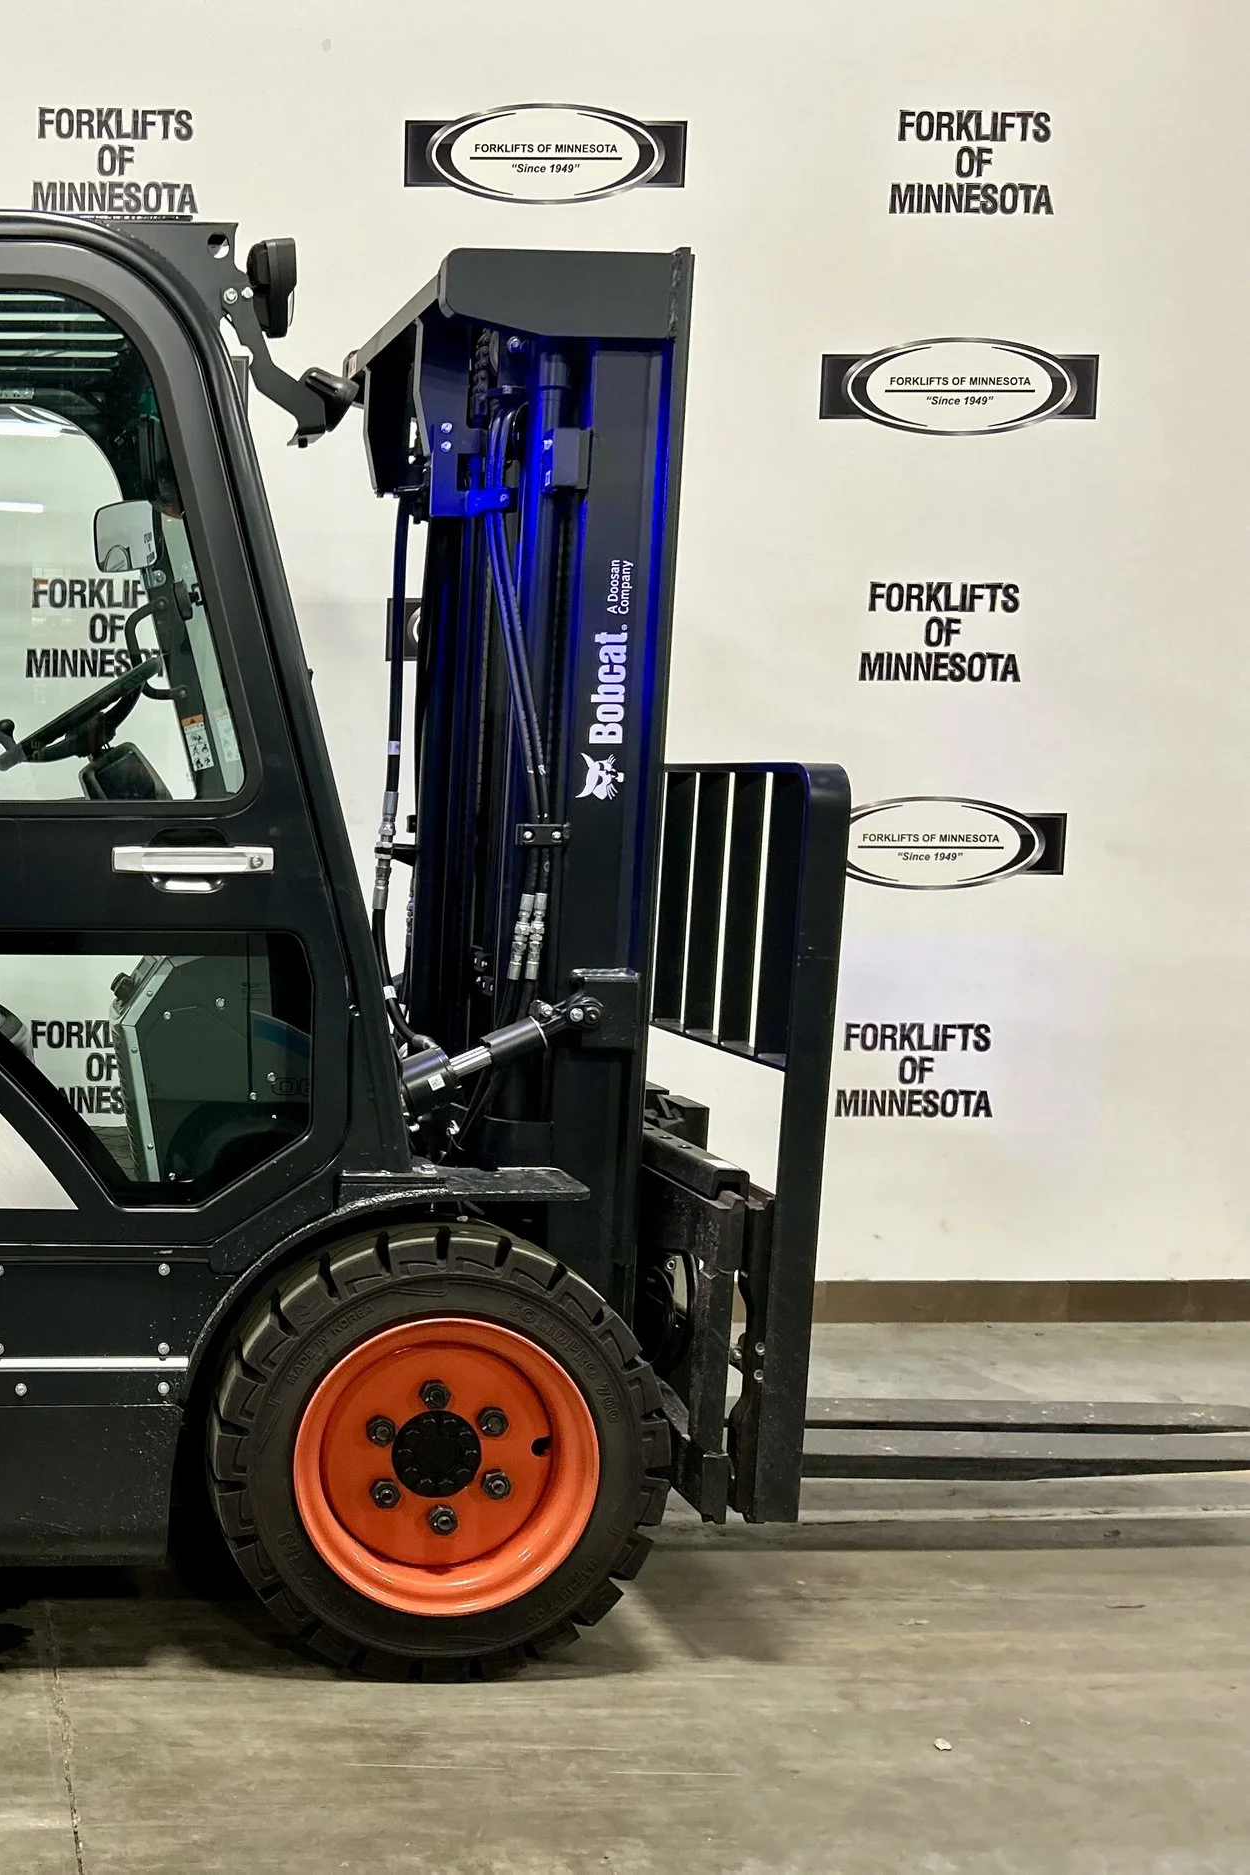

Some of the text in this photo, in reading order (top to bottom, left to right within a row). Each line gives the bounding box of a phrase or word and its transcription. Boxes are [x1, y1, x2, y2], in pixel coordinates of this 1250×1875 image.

[38, 107, 193, 141] FORKLIFTS
[898, 109, 1051, 143] FORKLIFTS
[97, 144, 135, 177] OF
[474, 143, 618, 154] FORKLIFTS OF MINNESOTA
[955, 146, 993, 178] OF
[33, 180, 198, 213] MINNESOTA
[889, 182, 1054, 215] MINNESOTA
[889, 376, 1032, 386] FORKLIFTS OF MINNESOTA
[32, 578, 146, 608] FORKLIF
[607, 559, 621, 615] A Doosan
[618, 560, 634, 615] Company
[868, 581, 1020, 613] FORKLIFTS
[89, 613, 125, 643] OF
[924, 616, 962, 647] OF
[26, 649, 163, 677] MINNES
[858, 651, 1021, 682] MINNESOTA
[588, 631, 628, 744] Bobcat
[862, 832, 1000, 844] FORKLIFTS OF MINNESOTA
[31, 1020, 114, 1048] FORKL
[843, 1022, 991, 1052] FORKLIFTS
[86, 1052, 118, 1081] OF
[898, 1055, 935, 1085] OF
[834, 1089, 993, 1118] MINNESOTA
